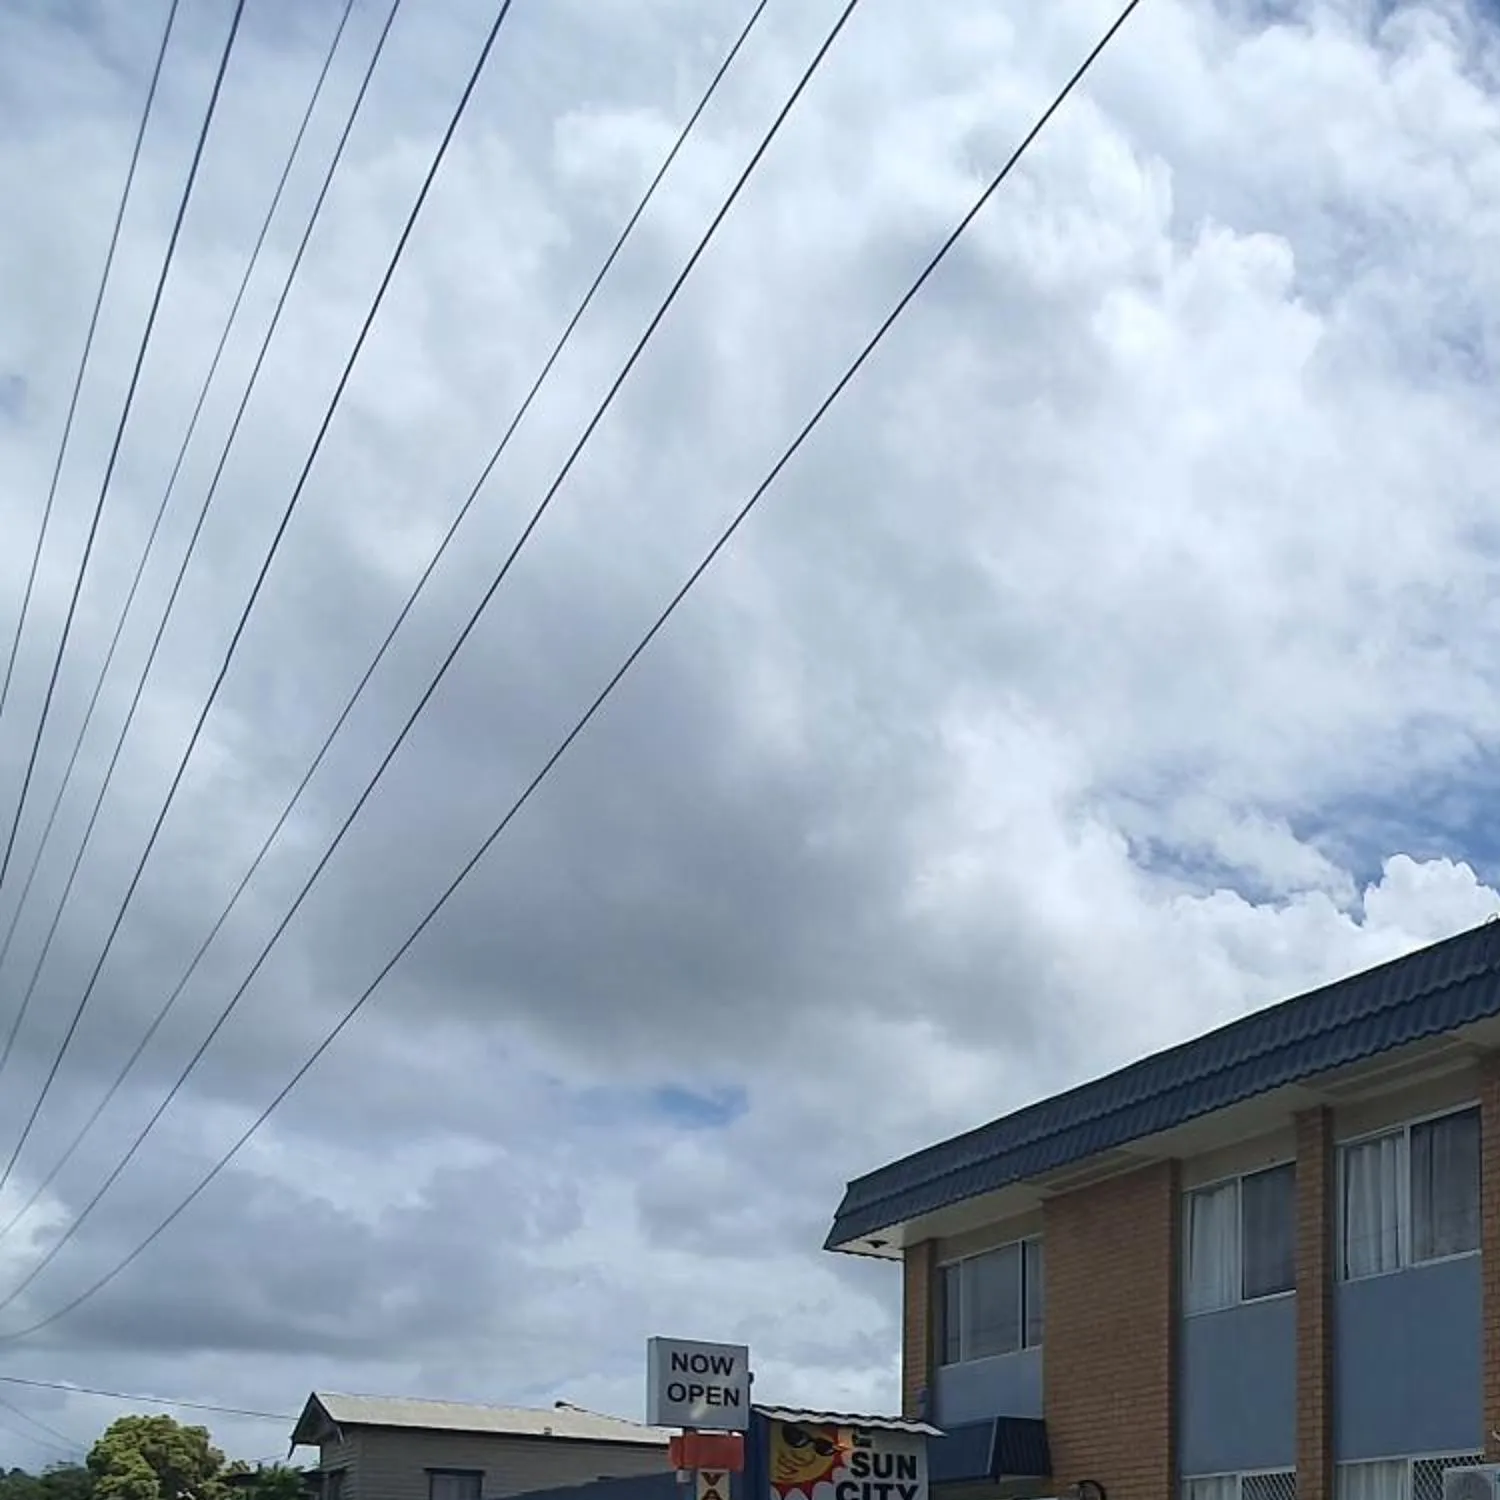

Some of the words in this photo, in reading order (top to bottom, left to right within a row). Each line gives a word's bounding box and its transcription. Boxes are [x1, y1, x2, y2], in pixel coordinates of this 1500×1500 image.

[671, 1352, 734, 1377] NOW
[667, 1383, 740, 1407] OPEN
[850, 1451, 917, 1480] SUN
